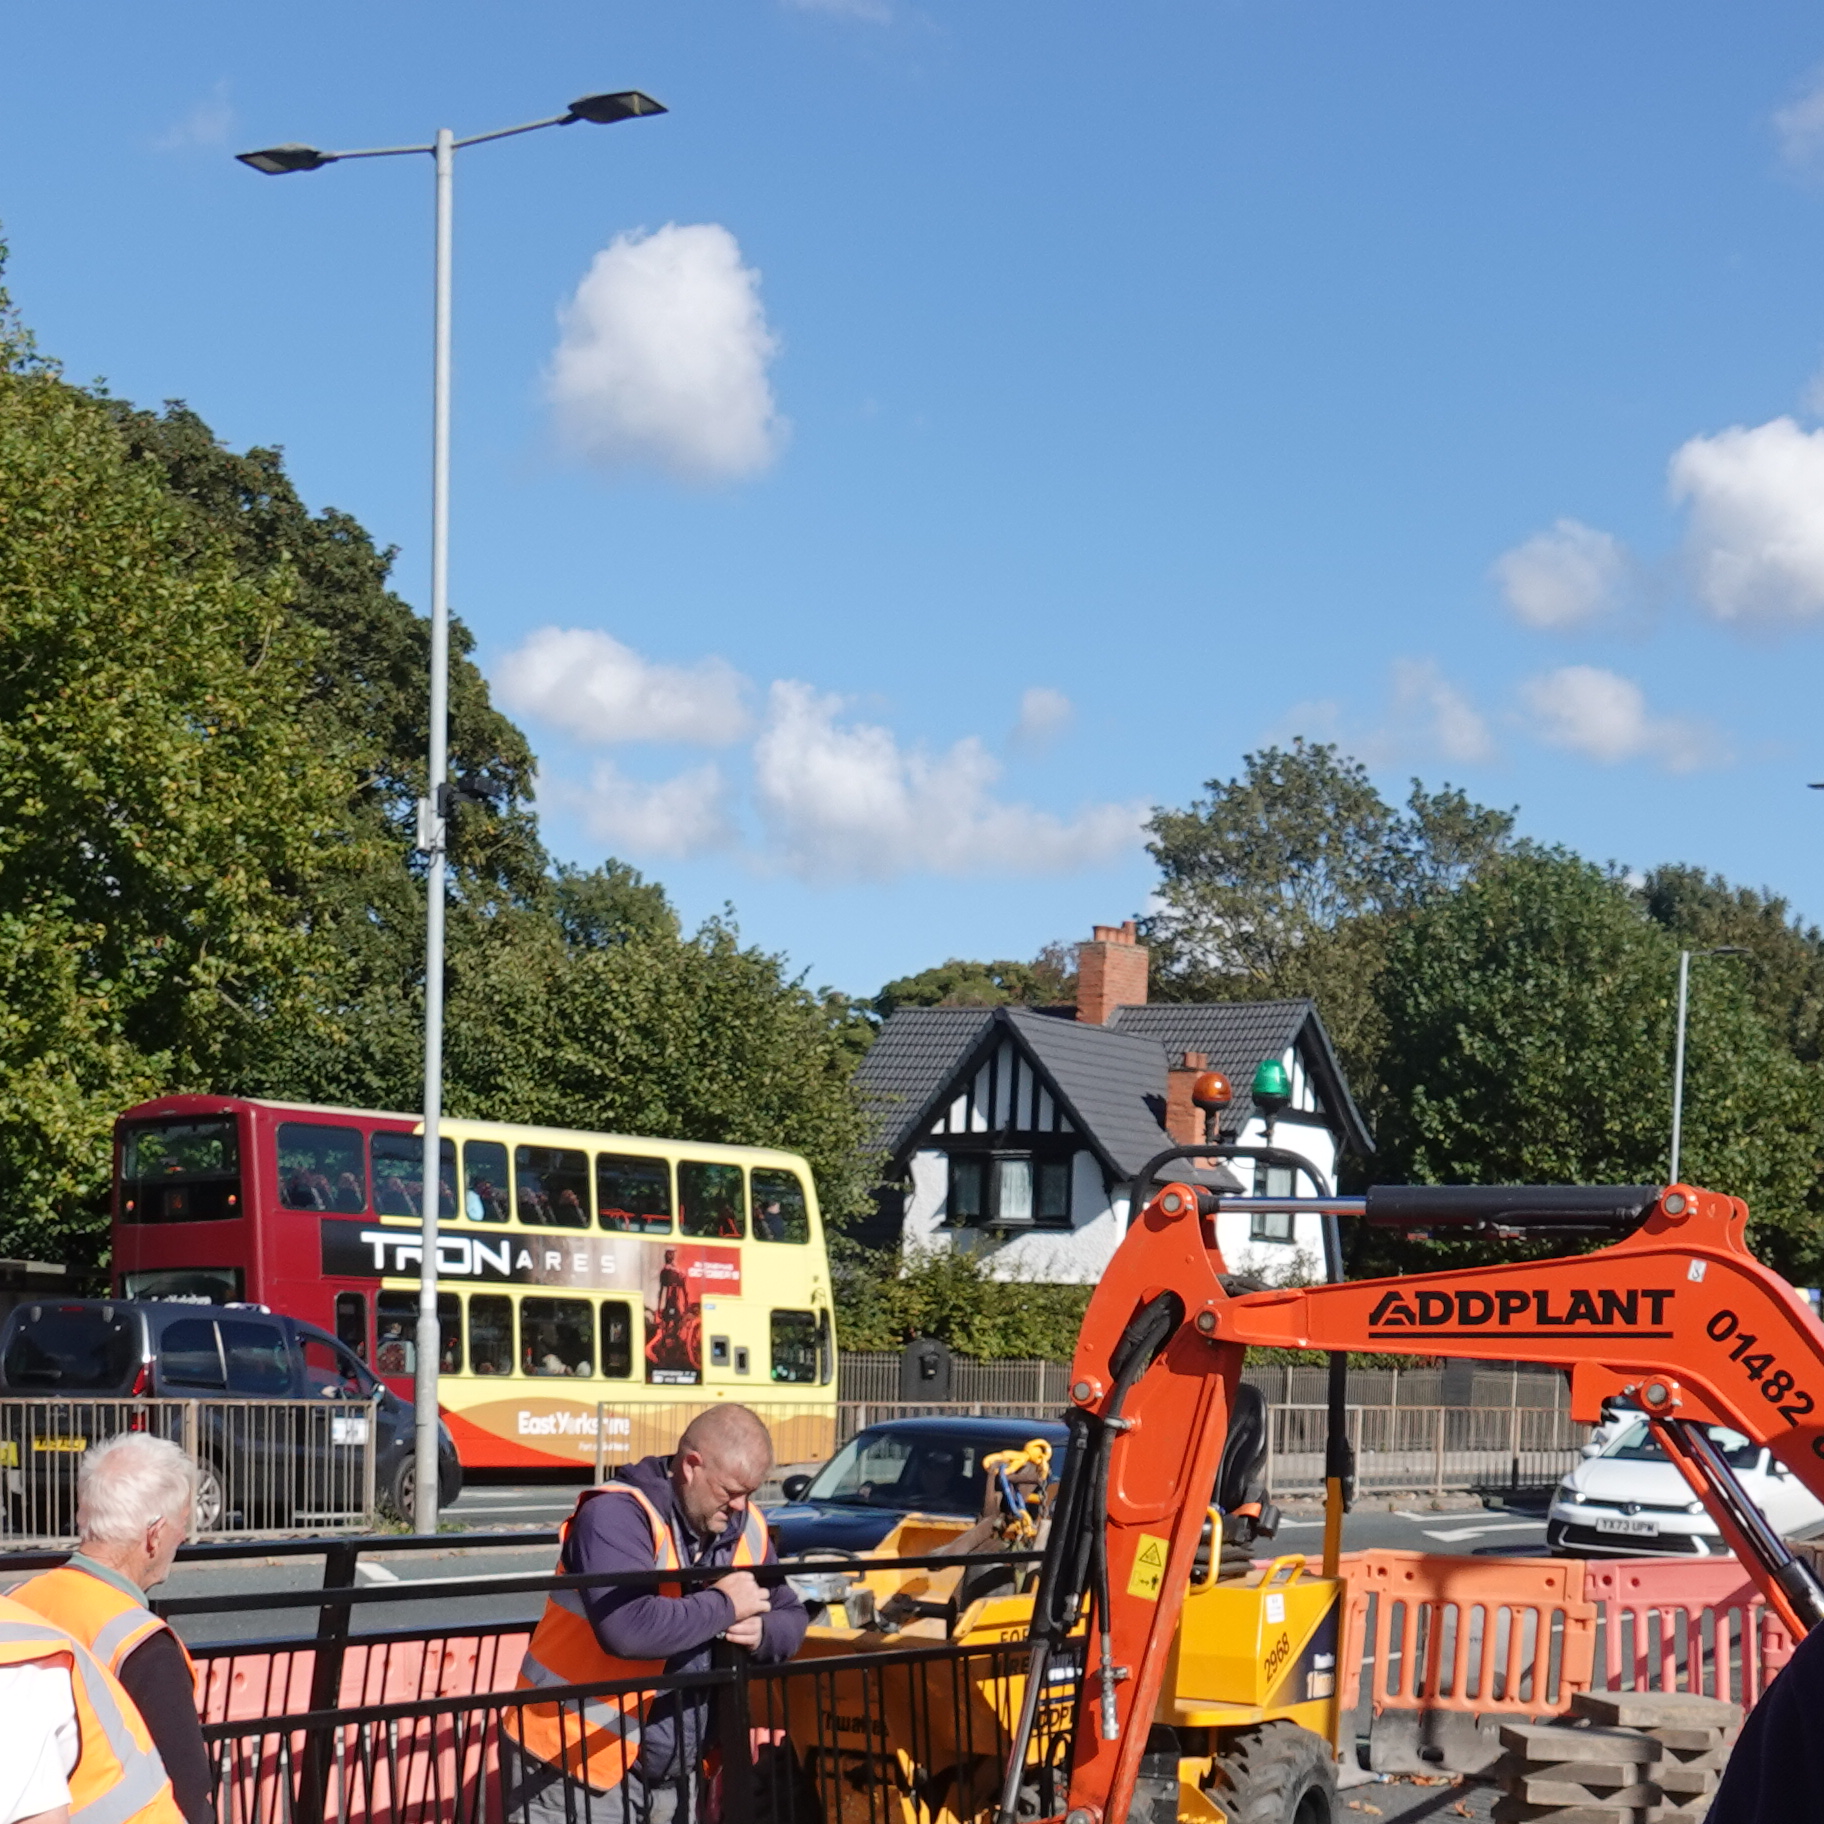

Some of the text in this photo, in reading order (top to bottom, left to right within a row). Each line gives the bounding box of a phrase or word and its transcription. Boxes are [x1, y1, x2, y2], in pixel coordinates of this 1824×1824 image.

[360, 1231, 617, 1277] TRON ARES
[1369, 1288, 1676, 1327] ADDPLANT
[1706, 1308, 1815, 1428] 01482
[1264, 1631, 1290, 1684] 2968
